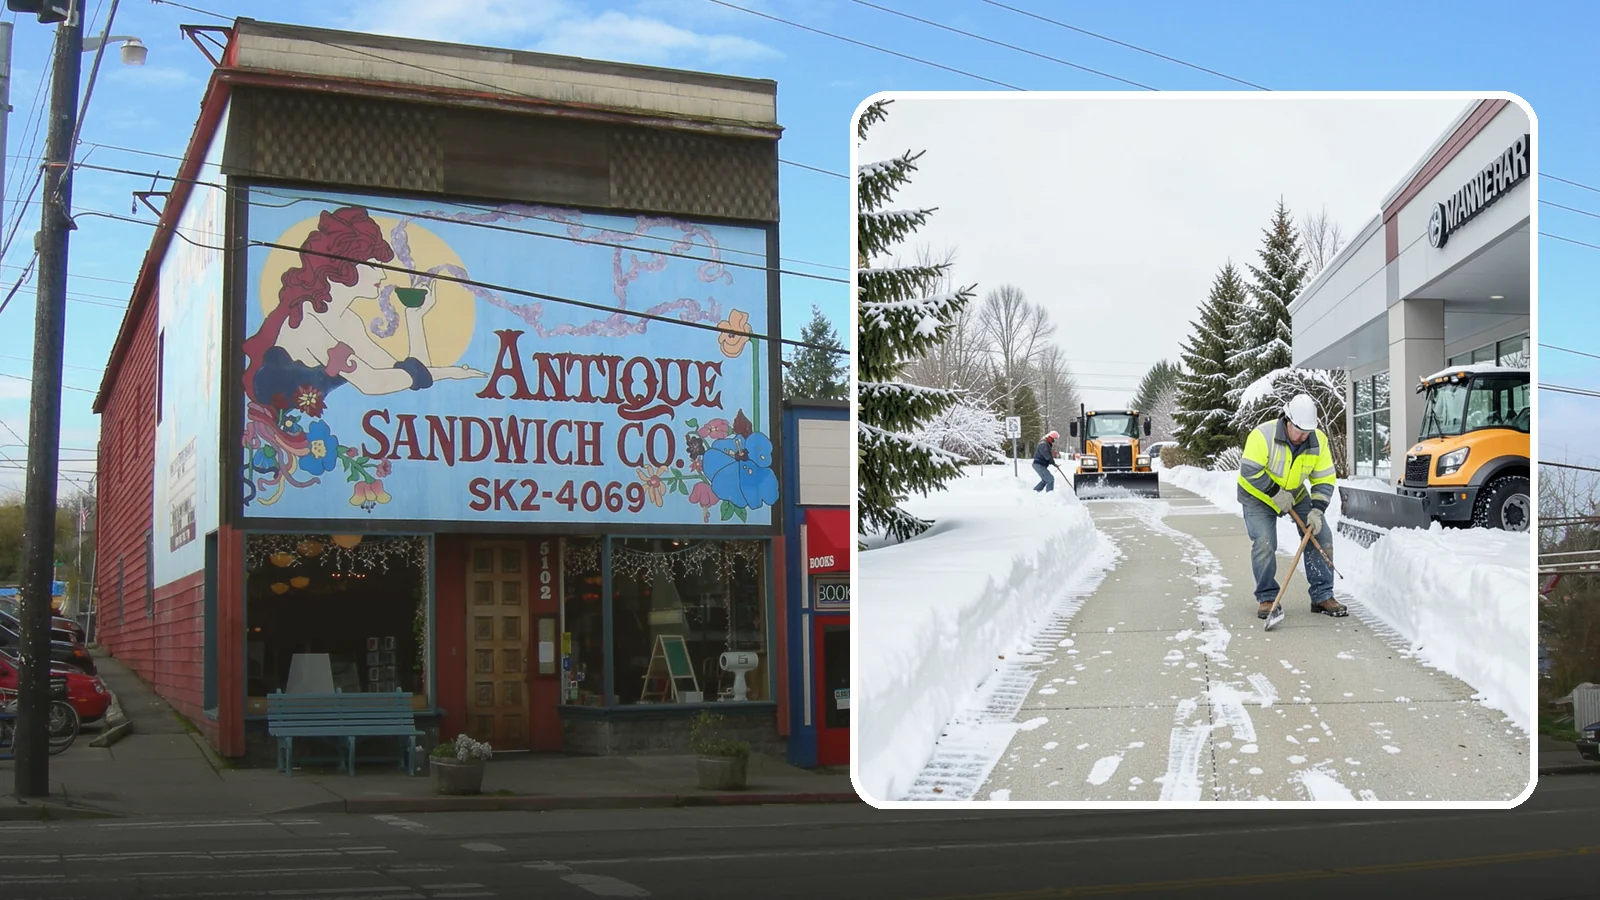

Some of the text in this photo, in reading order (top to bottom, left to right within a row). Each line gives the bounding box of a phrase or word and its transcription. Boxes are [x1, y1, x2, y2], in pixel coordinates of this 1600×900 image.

[475, 329, 723, 420] ANTIQUE
[361, 408, 685, 468] SANDWICH CO.
[469, 477, 645, 511] SK2-4069
[540, 542, 551, 600] 5102
[809, 555, 835, 569] BOOKS
